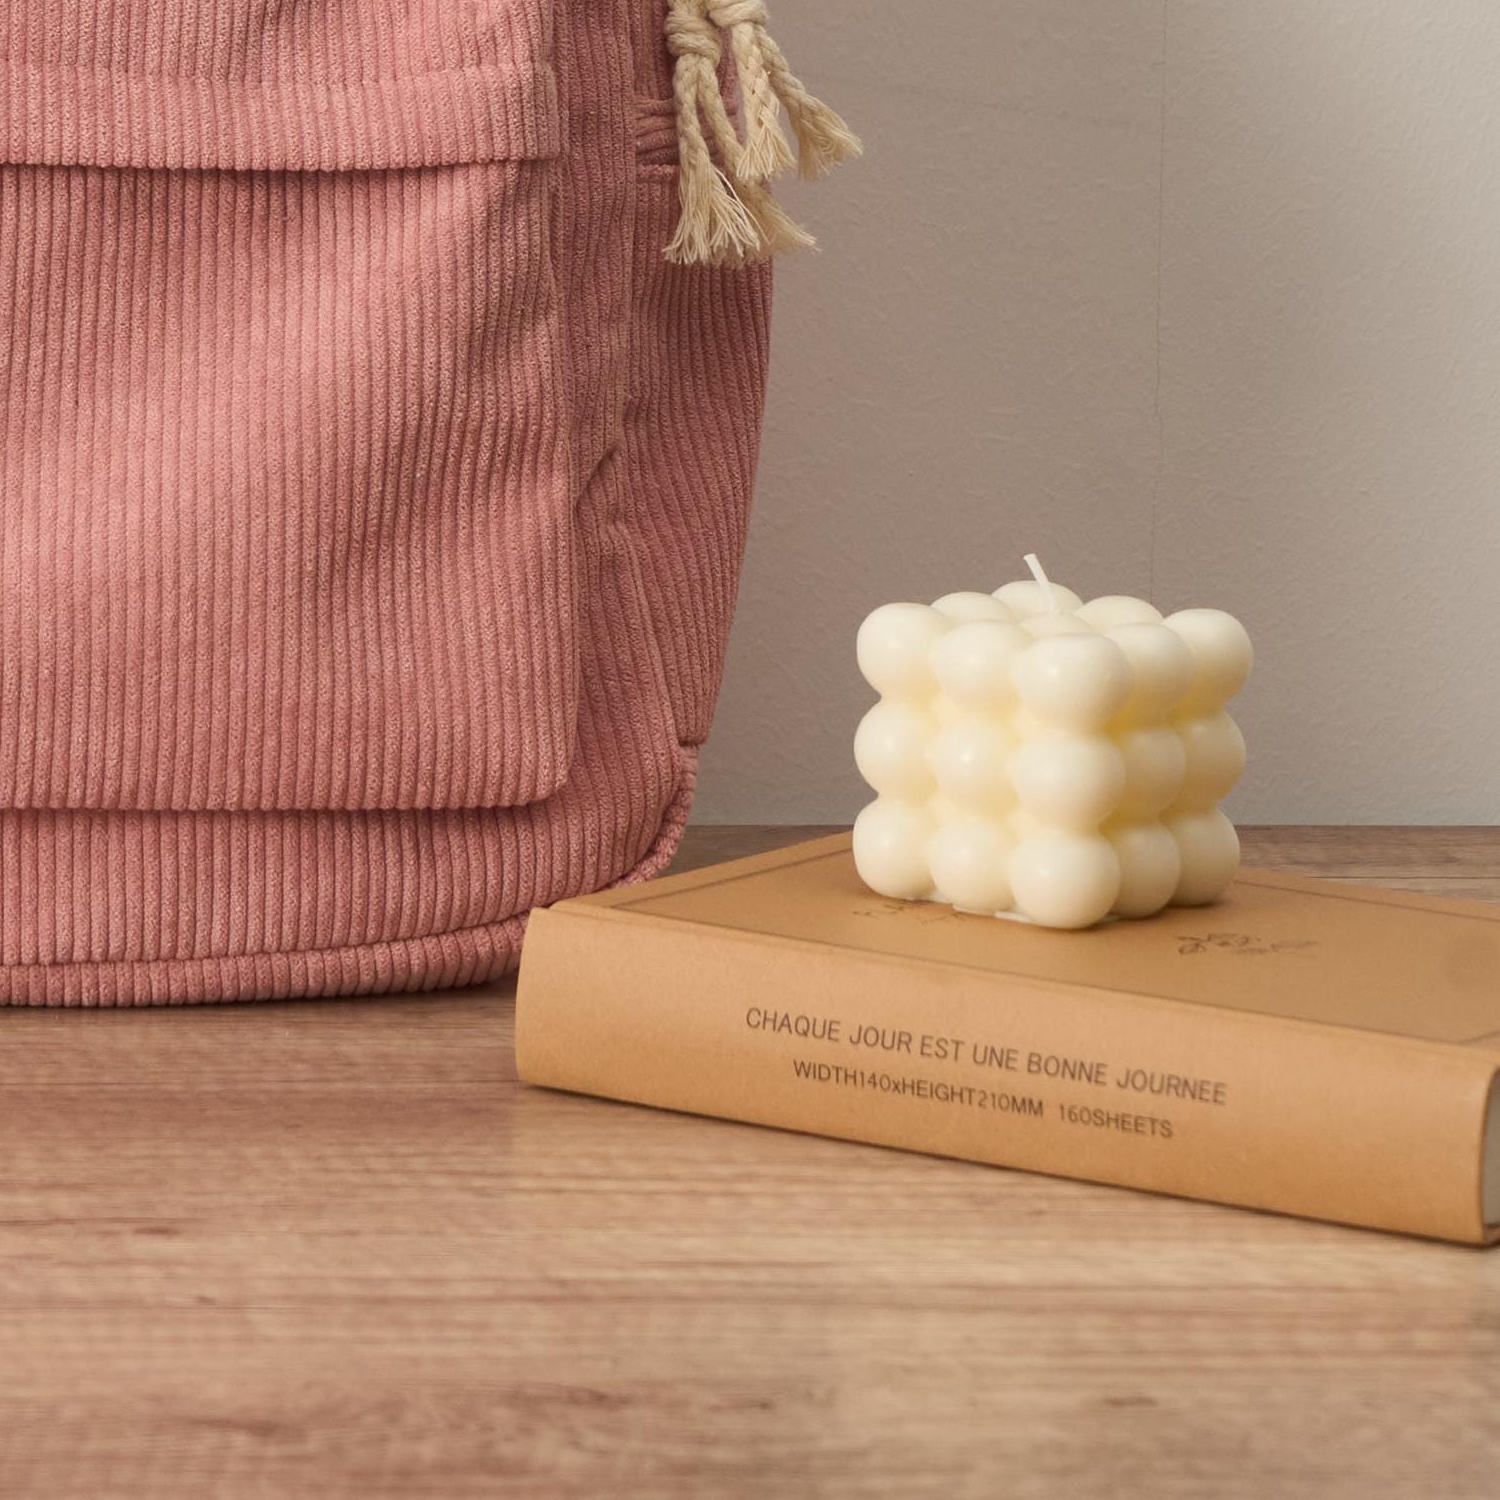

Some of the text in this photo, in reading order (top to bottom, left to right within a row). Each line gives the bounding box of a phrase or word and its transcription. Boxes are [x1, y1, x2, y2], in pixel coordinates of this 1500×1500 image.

[746, 1006, 1228, 1105] CHAQUE JOUR EST UNE BONNE JOURNEE
[1058, 1102, 1174, 1140] 160SHEETS
